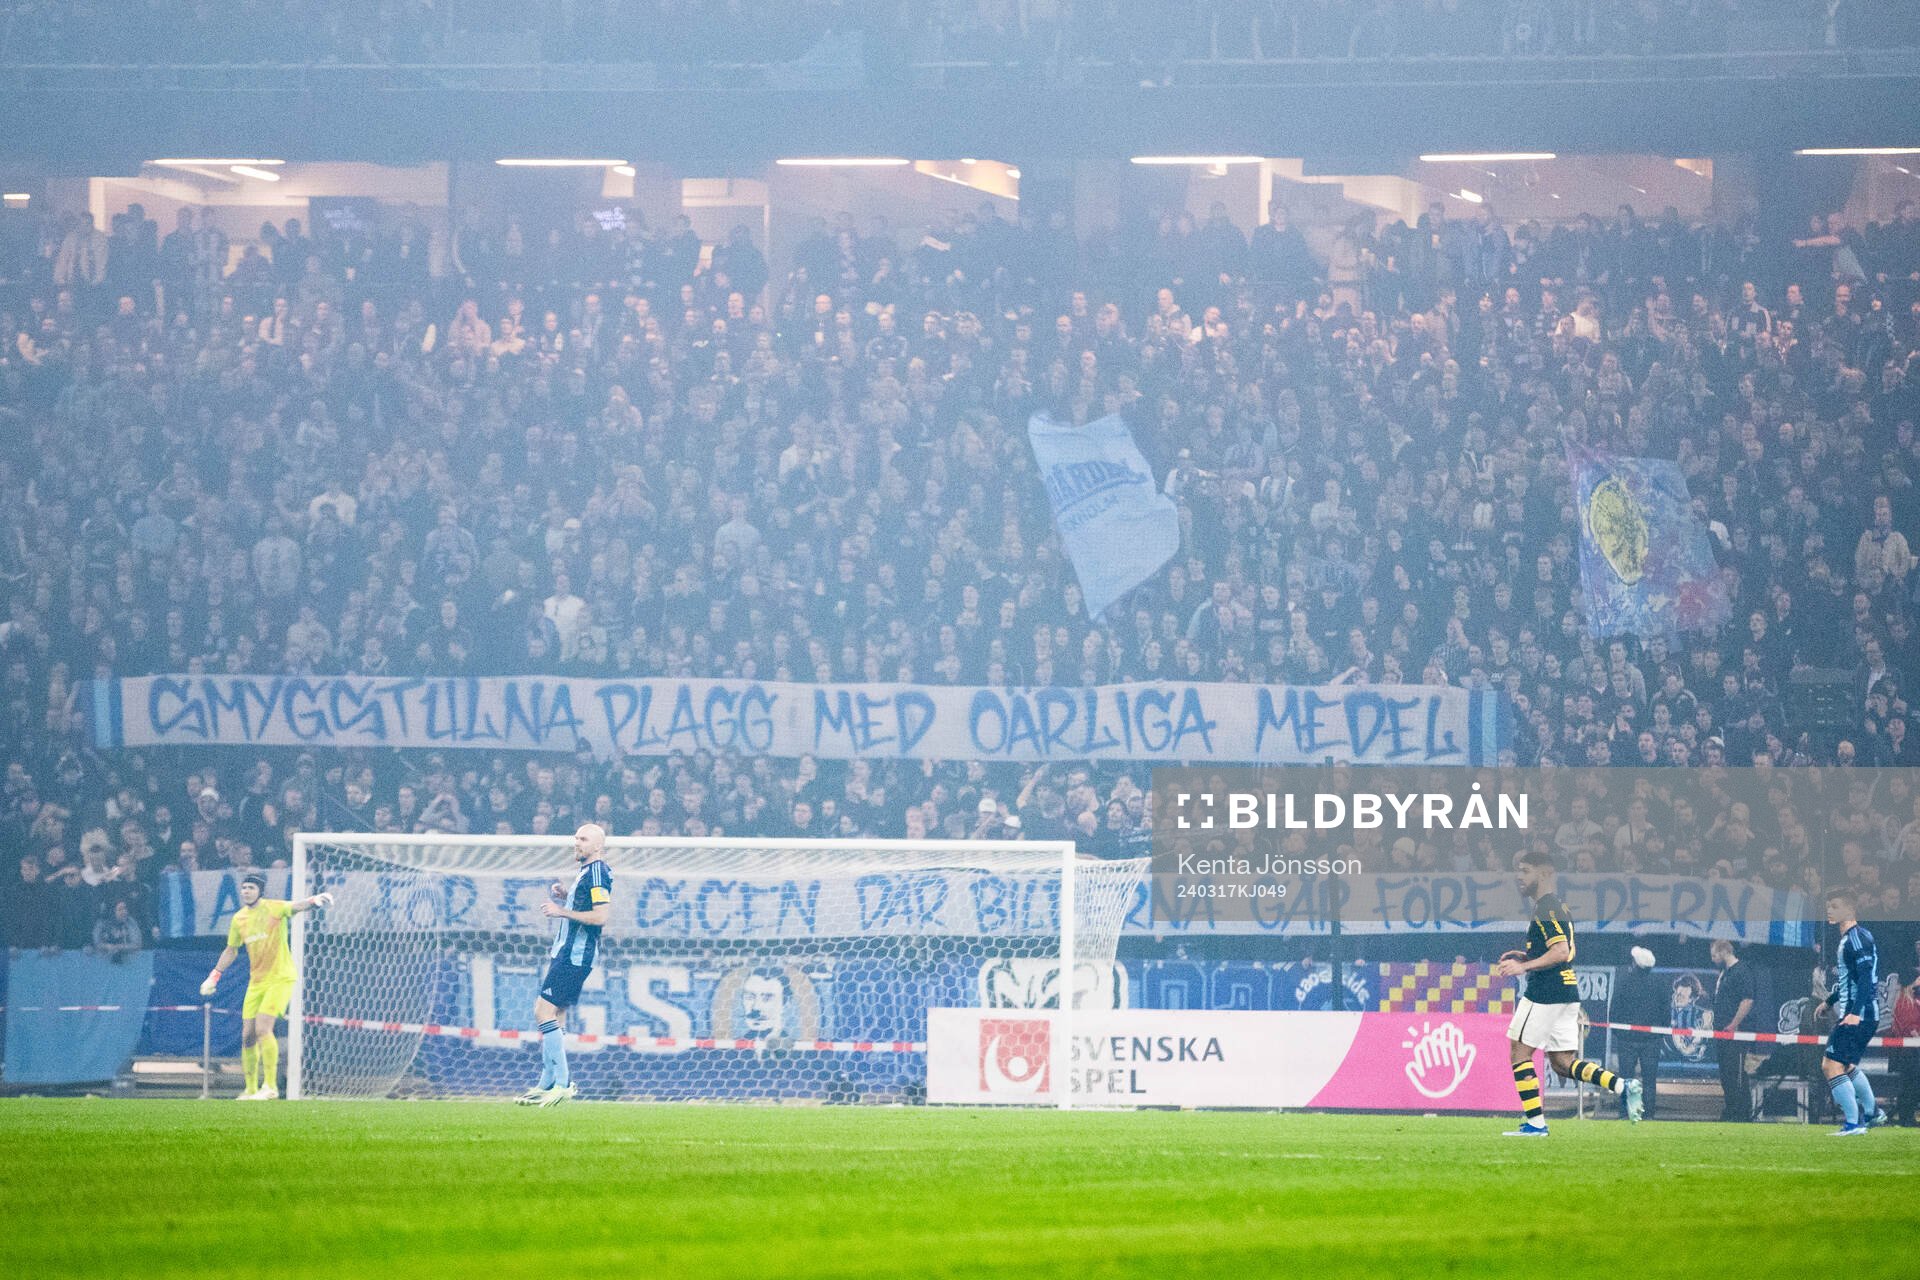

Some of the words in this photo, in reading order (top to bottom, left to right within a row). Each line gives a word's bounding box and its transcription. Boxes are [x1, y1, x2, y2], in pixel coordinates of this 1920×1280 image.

[148, 674, 583, 744] SMYGSTULNA
[595, 683, 778, 750] PLAGG
[815, 688, 935, 755] MED
[1255, 687, 1461, 760] MEDEL
[1372, 876, 1502, 929] FÖRE
[1071, 1036, 1225, 1062] SVENSKA
[1071, 1069, 1148, 1094] SPEL
